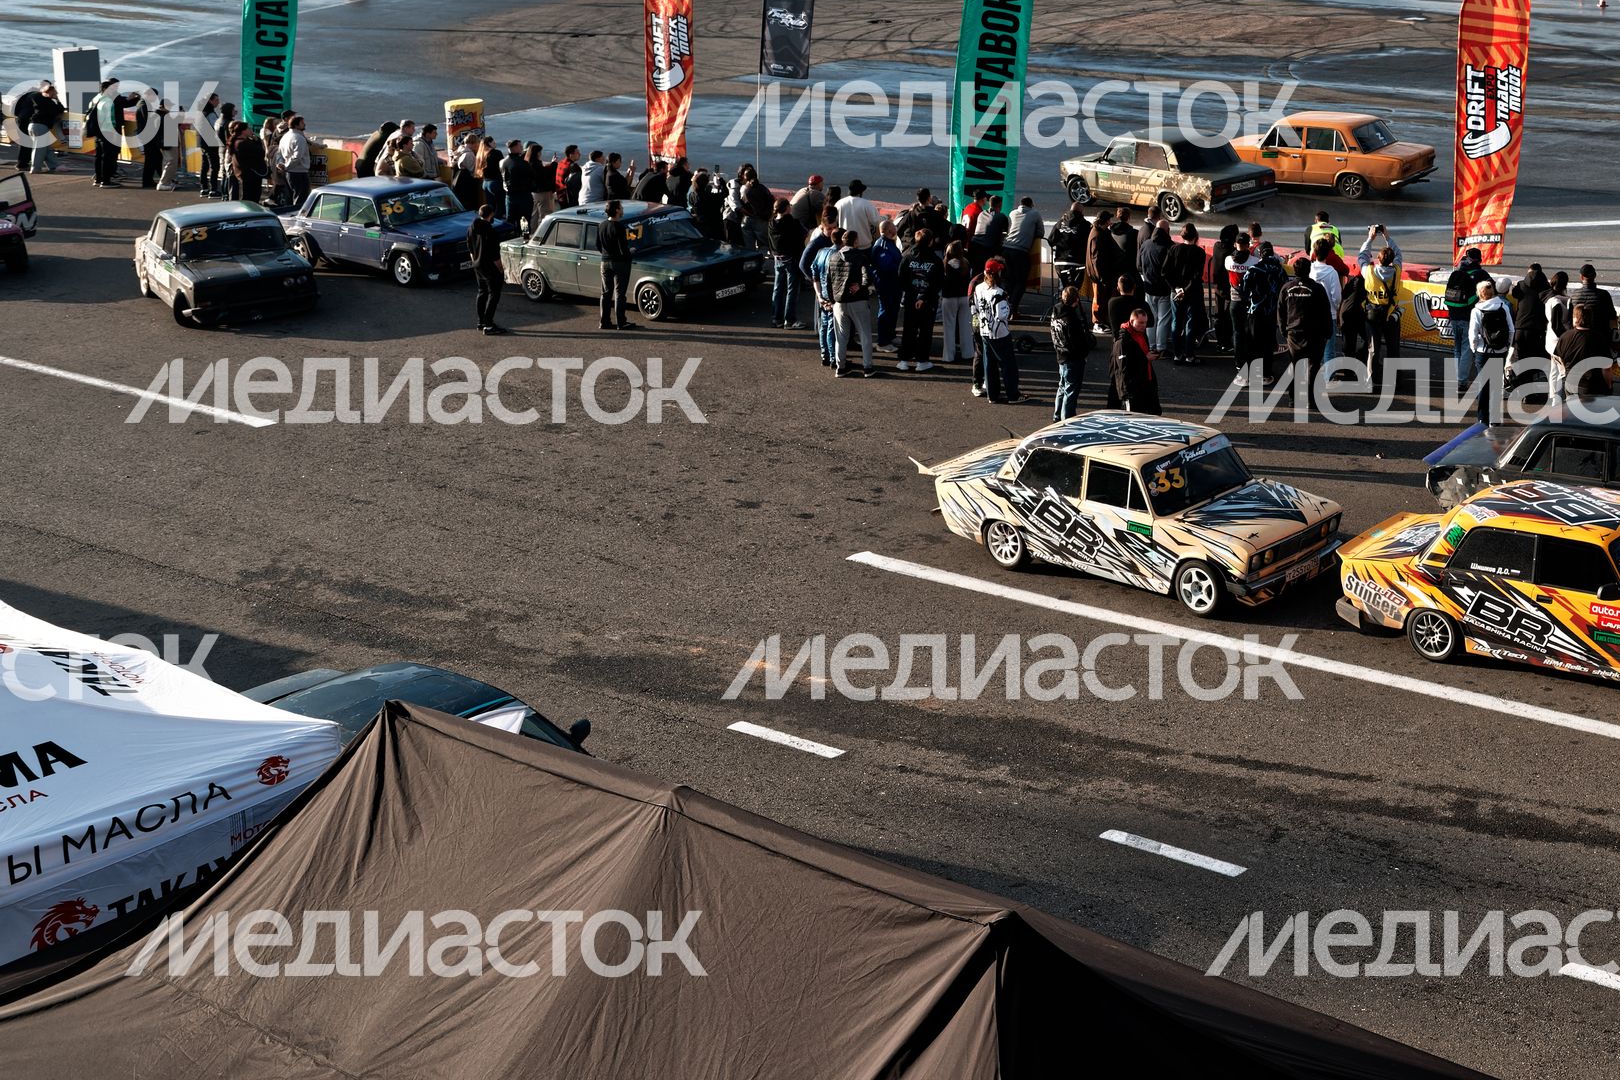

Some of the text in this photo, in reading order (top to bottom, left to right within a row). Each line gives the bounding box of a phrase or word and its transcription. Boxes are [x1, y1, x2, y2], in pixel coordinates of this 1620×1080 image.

[652, 14, 665, 69] DRIFT
[253, 55, 287, 118] ЛИГА
[1467, 65, 1486, 131] DRIFT
[1496, 68, 1509, 120] TRACK
[1508, 65, 1522, 113] MODE
[181, 226, 208, 244] 23
[380, 201, 405, 217] 56
[1154, 467, 1185, 493] 33
[1032, 496, 1104, 559] BR
[1367, 580, 1406, 604] auto
[1466, 591, 1555, 647] BR
[1513, 637, 1548, 654] RACING
[62, 782, 233, 864] МАСЛА
